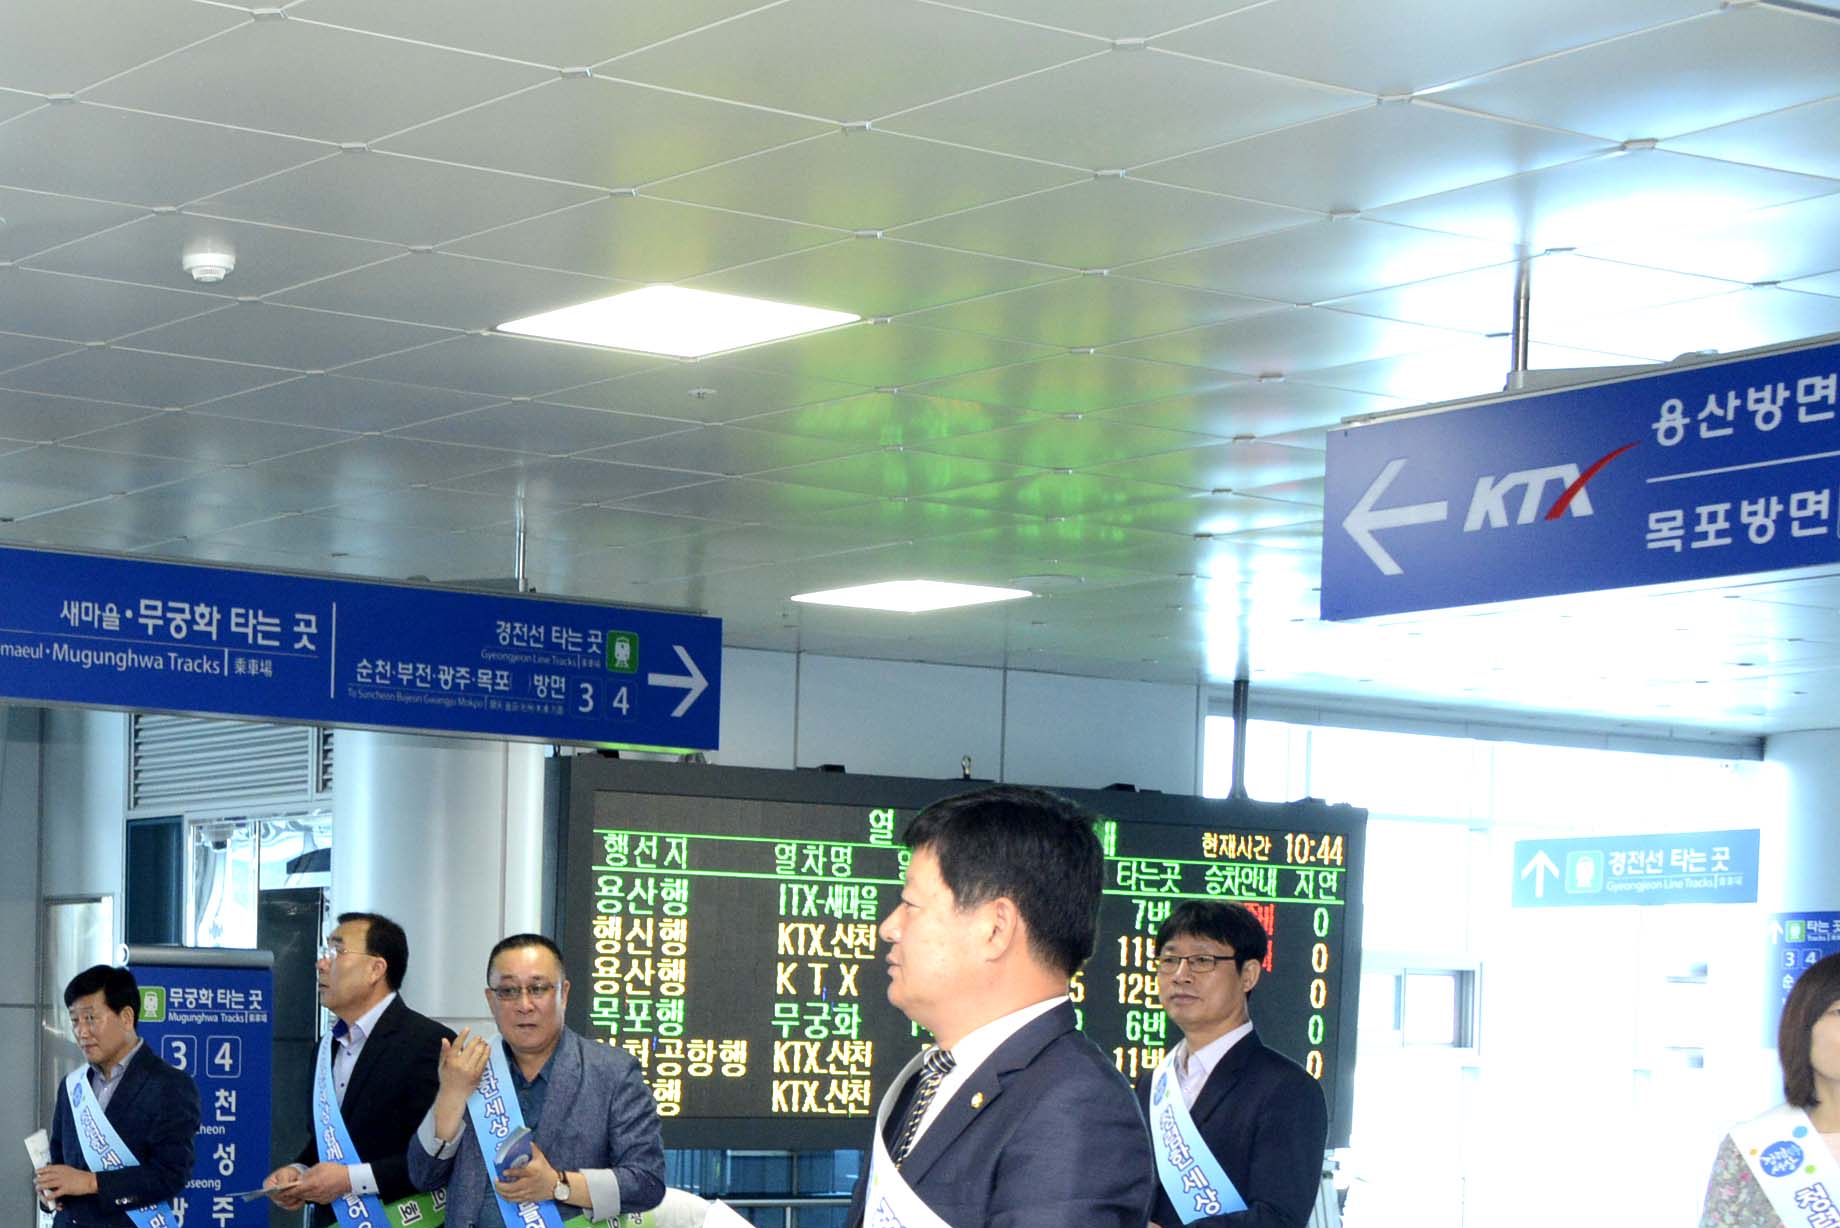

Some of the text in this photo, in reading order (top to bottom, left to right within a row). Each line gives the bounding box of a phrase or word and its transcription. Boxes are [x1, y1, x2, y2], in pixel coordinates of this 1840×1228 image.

[1650, 372, 1838, 446] 용산방면
[1463, 440, 1642, 532] KTX
[1645, 488, 1831, 552] 목포방면
[229, 607, 282, 647] 타는
[293, 611, 319, 651] 곳
[495, 619, 603, 655] 경전선 타는 곳
[167, 652, 221, 675] Tracks
[578, 681, 594, 714] 3
[612, 685, 630, 717] 4
[603, 832, 1338, 900] 행선지 열차명 타는곳 승차안내 지연
[1201, 832, 1344, 866] 현재시간 10:44
[1607, 846, 1731, 877] 경전선 타는 곳
[594, 875, 689, 918] 용산행
[1313, 907, 1330, 938] 0
[1806, 919, 1830, 933] 타는
[592, 914, 688, 957] 행신행
[1311, 942, 1328, 974] 0
[1784, 950, 1796, 967] 3
[1804, 950, 1817, 965] 4
[169, 987, 263, 1010] 무궁화 타는 곳
[592, 956, 686, 997] 용산행
[1309, 977, 1327, 1009] 0
[168, 1011, 219, 1024] Mugunghwa
[220, 1012, 245, 1024] Tracks
[590, 996, 1324, 1046] 목포행 무궁화 6번 0
[170, 1040, 188, 1071] 3
[213, 1041, 234, 1072] 4
[214, 1088, 237, 1122] 천
[100, 1147, 123, 1171] 세
[213, 1143, 236, 1177] 성
[185, 1178, 222, 1191] oseong
[1182, 1168, 1223, 1217] 세상
